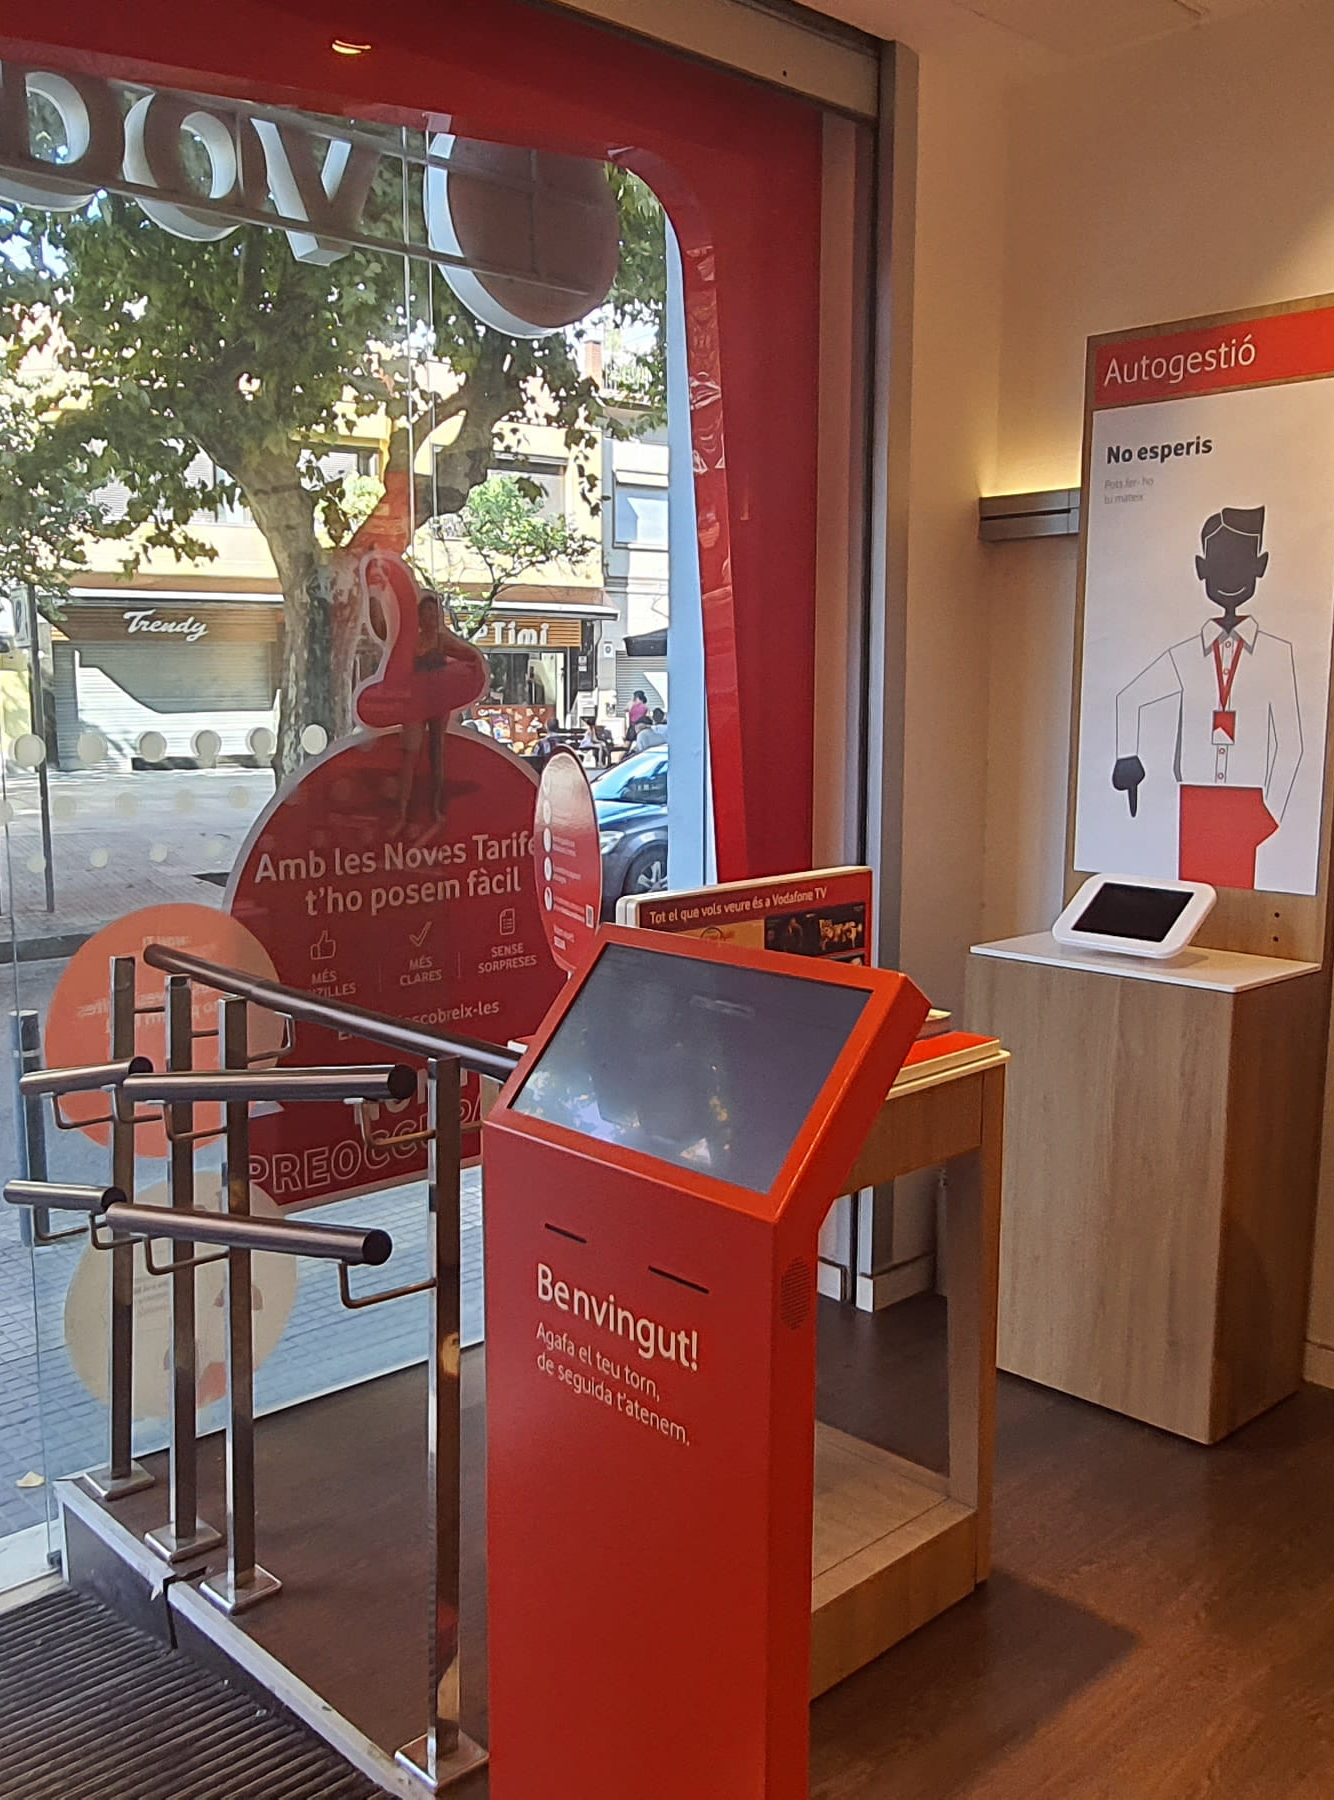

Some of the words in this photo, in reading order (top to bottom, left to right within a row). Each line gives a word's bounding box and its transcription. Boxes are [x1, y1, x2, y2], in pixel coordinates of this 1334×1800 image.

[1104, 334, 1256, 387] Autogestió
[1107, 445, 1133, 464] No
[1137, 435, 1213, 463] esperis
[123, 608, 209, 642] Trendy
[255, 850, 326, 884] Amb
[334, 847, 377, 877] les
[384, 841, 467, 871] Noves
[472, 830, 535, 861] Tarife
[370, 879, 461, 916] posem
[467, 866, 522, 897] fàcil
[649, 911, 666, 925] Tot
[668, 906, 678, 921] el
[680, 908, 700, 925] que
[701, 900, 722, 917] vols
[724, 900, 751, 914] veure
[752, 895, 764, 909] és
[765, 898, 771, 908] a
[772, 889, 814, 907] Vodafone
[815, 886, 828, 901] TV
[408, 955, 433, 971] MÉS
[477, 954, 537, 974] SORPRESES
[491, 943, 524, 958] SENSE
[308, 982, 357, 998] ZILLES
[311, 967, 337, 985] MÉS
[399, 969, 443, 987] CLARES
[537, 1263, 698, 1372] Benvingut!
[536, 1322, 575, 1357] Agafa
[579, 1345, 593, 1366] el
[596, 1351, 620, 1379] teu
[624, 1365, 660, 1402] torn,
[537, 1352, 554, 1375] de
[557, 1364, 613, 1406] seguida
